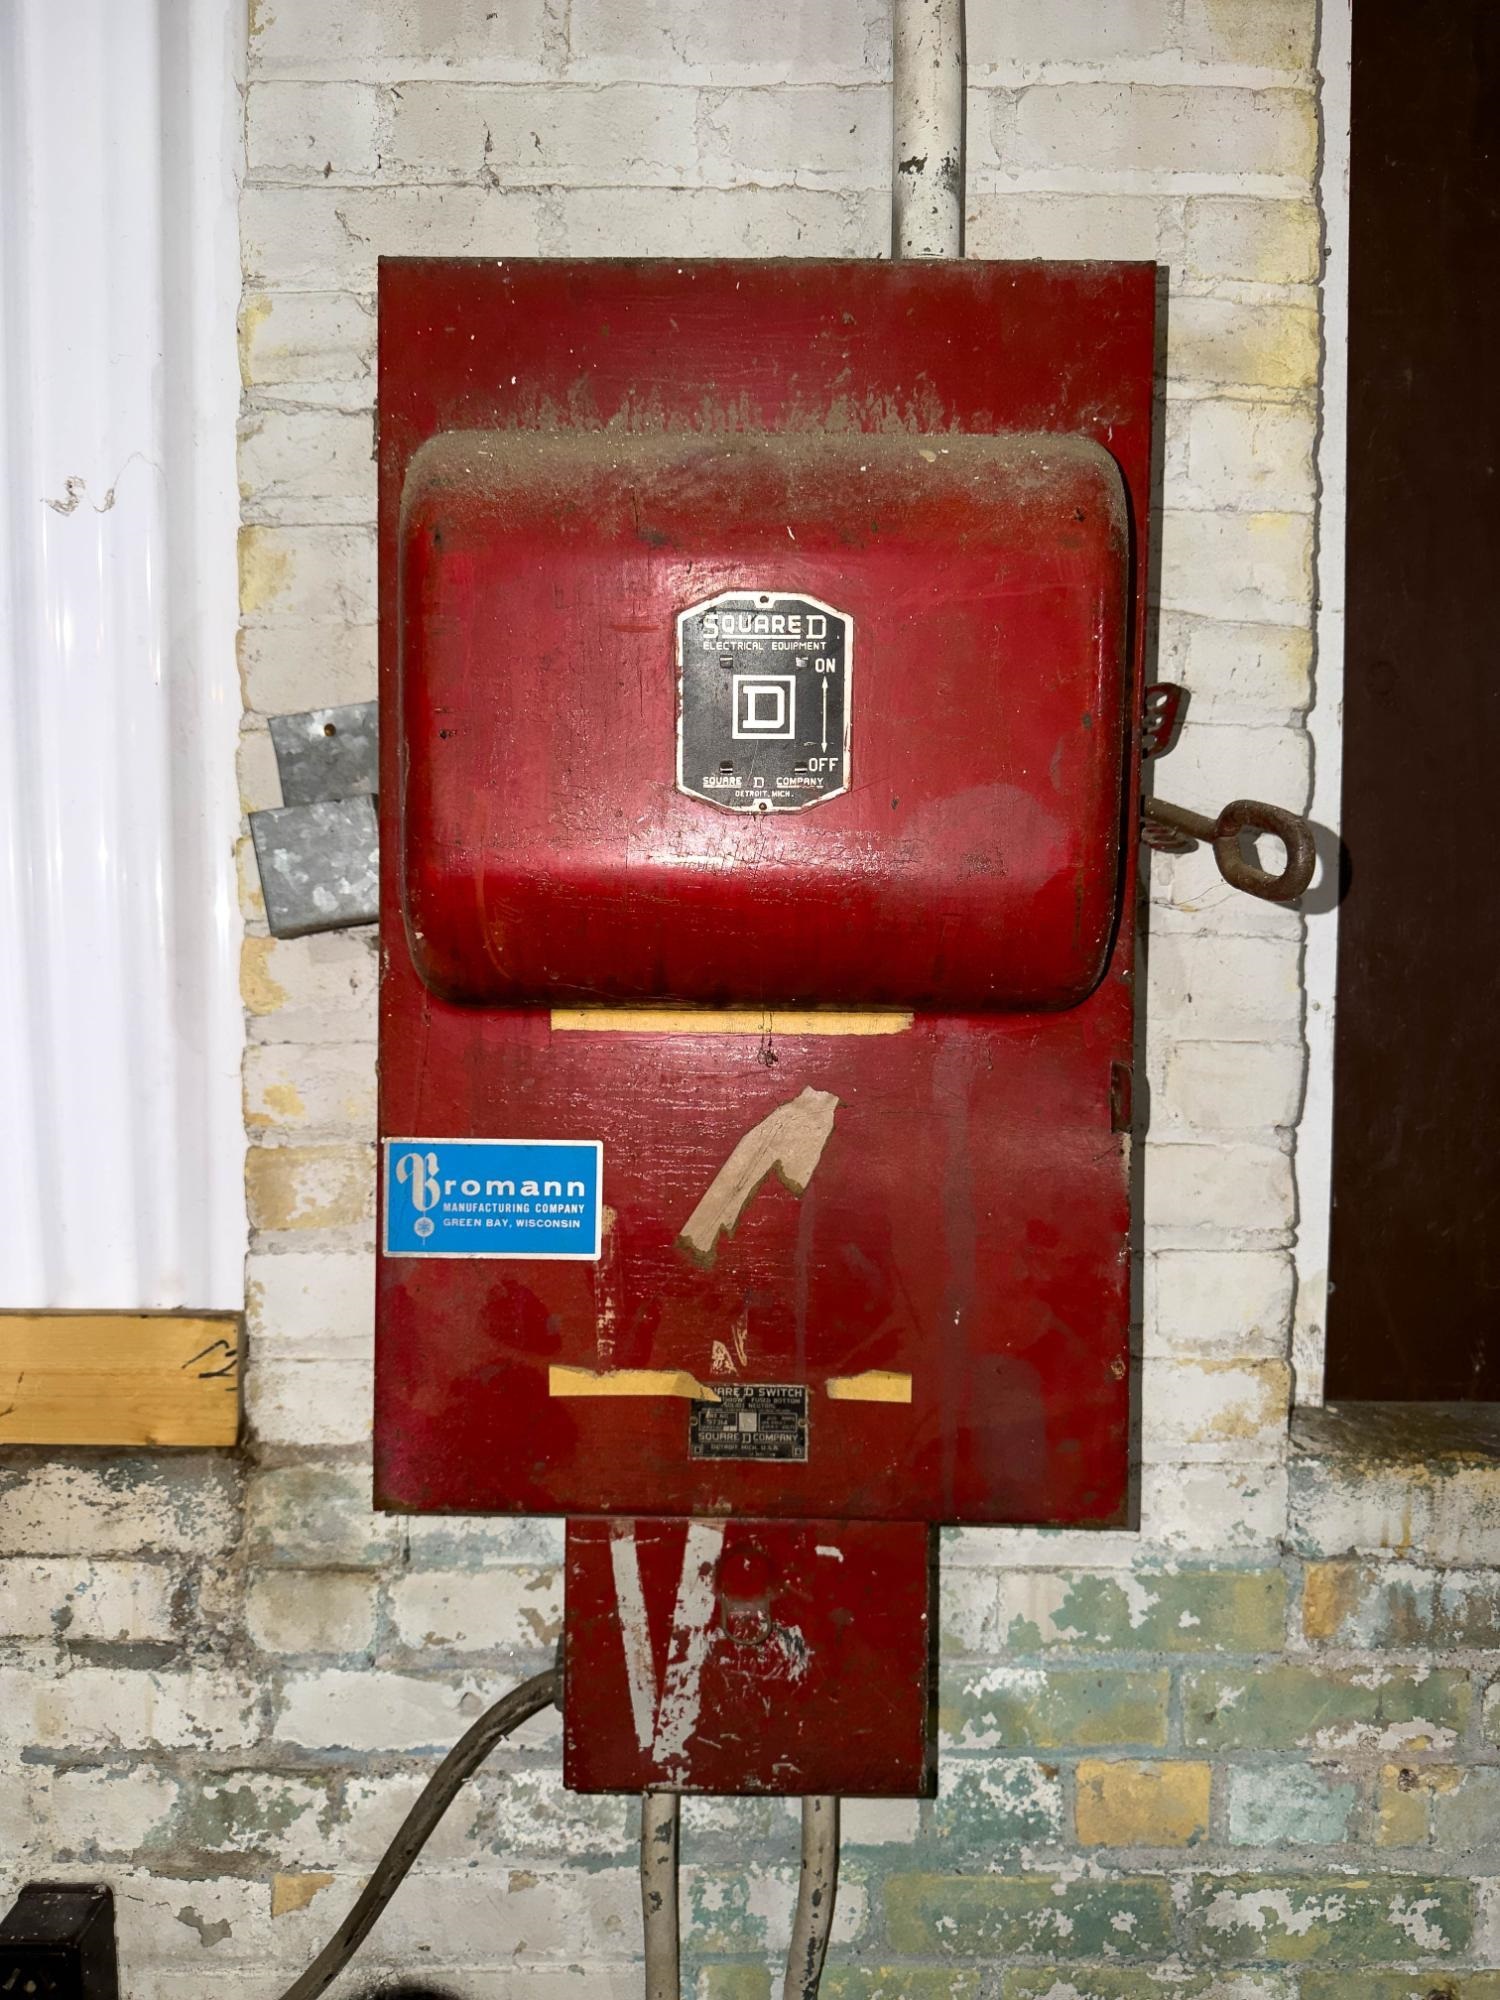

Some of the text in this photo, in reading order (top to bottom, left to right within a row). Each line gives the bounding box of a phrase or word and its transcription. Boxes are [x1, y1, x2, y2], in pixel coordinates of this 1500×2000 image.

[702, 614, 827, 640] SQUARE D
[702, 641, 828, 651] ELECTRICAL EQUIPMENT
[814, 658, 836, 673] ON
[808, 757, 839, 772] OFF
[702, 776, 825, 789] SQUARE D COMPANY
[771, 790, 795, 798] MICH.
[395, 1152, 585, 1212] Bromann
[442, 1202, 585, 1214] MANUFACTURING COMPANY
[443, 1217, 581, 1229] GREEN BAY, WISCONSIN
[758, 1387, 803, 1398] SWITCH
[698, 1432, 799, 1444] SQUARE D COMPANY
